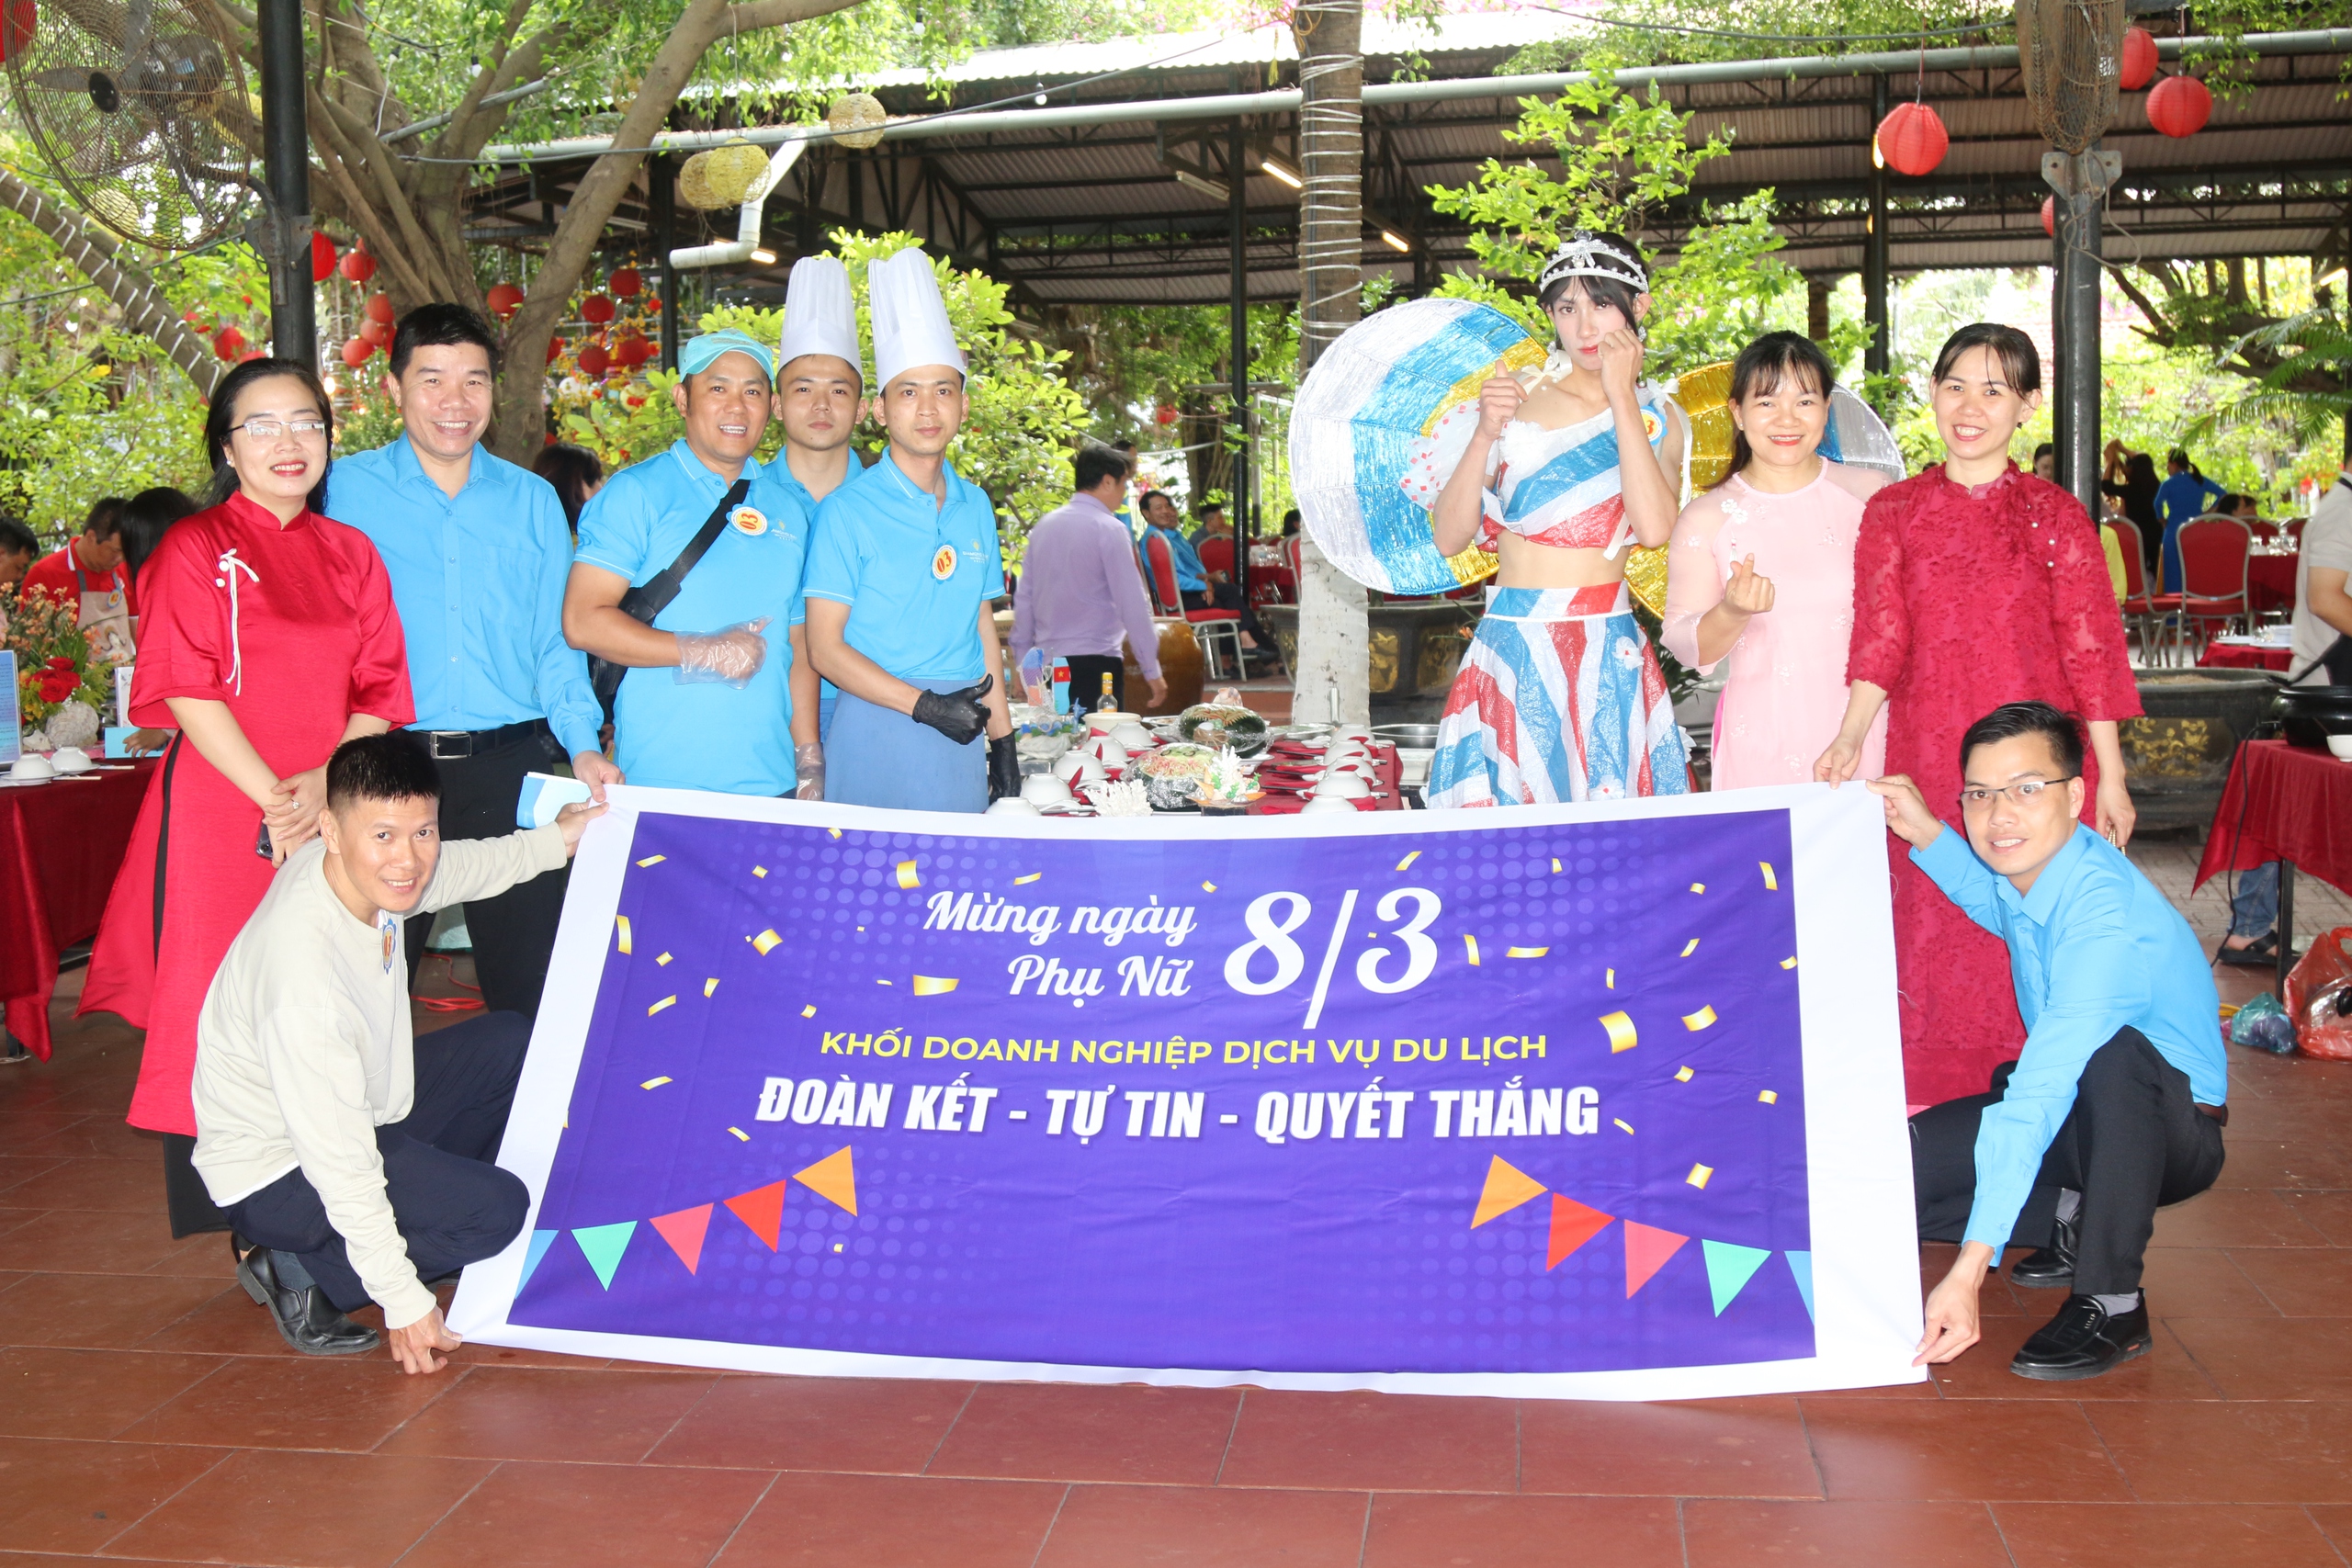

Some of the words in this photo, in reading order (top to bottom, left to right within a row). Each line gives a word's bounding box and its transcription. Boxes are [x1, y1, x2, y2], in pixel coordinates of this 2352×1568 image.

[740, 513, 758, 530] 03
[937, 551, 951, 572] 03
[923, 890, 1063, 945] Mừng
[1069, 895, 1197, 947] ngày
[1007, 954, 1105, 1007] Phụ
[1118, 956, 1194, 997] Nữ
[1224, 887, 1442, 1030] 8/3
[820, 1026, 912, 1057] KHỐI
[923, 1036, 1059, 1061] DOANH
[1071, 1035, 1213, 1068] NGHIỆP
[1224, 1040, 1316, 1069] DỊCH
[1327, 1039, 1380, 1069] VỤ
[1394, 1038, 1447, 1062] DU
[1461, 1034, 1547, 1067] LỊCH
[755, 1074, 894, 1128] ĐOÀN
[903, 1072, 999, 1133] KẾT
[1009, 1111, 1027, 1120] -
[1047, 1084, 1116, 1145] TỰ
[1125, 1090, 1205, 1139] TIN
[1219, 1114, 1238, 1123] -
[1255, 1077, 1415, 1145] QUYẾT
[1430, 1076, 1600, 1138] THẮNG
